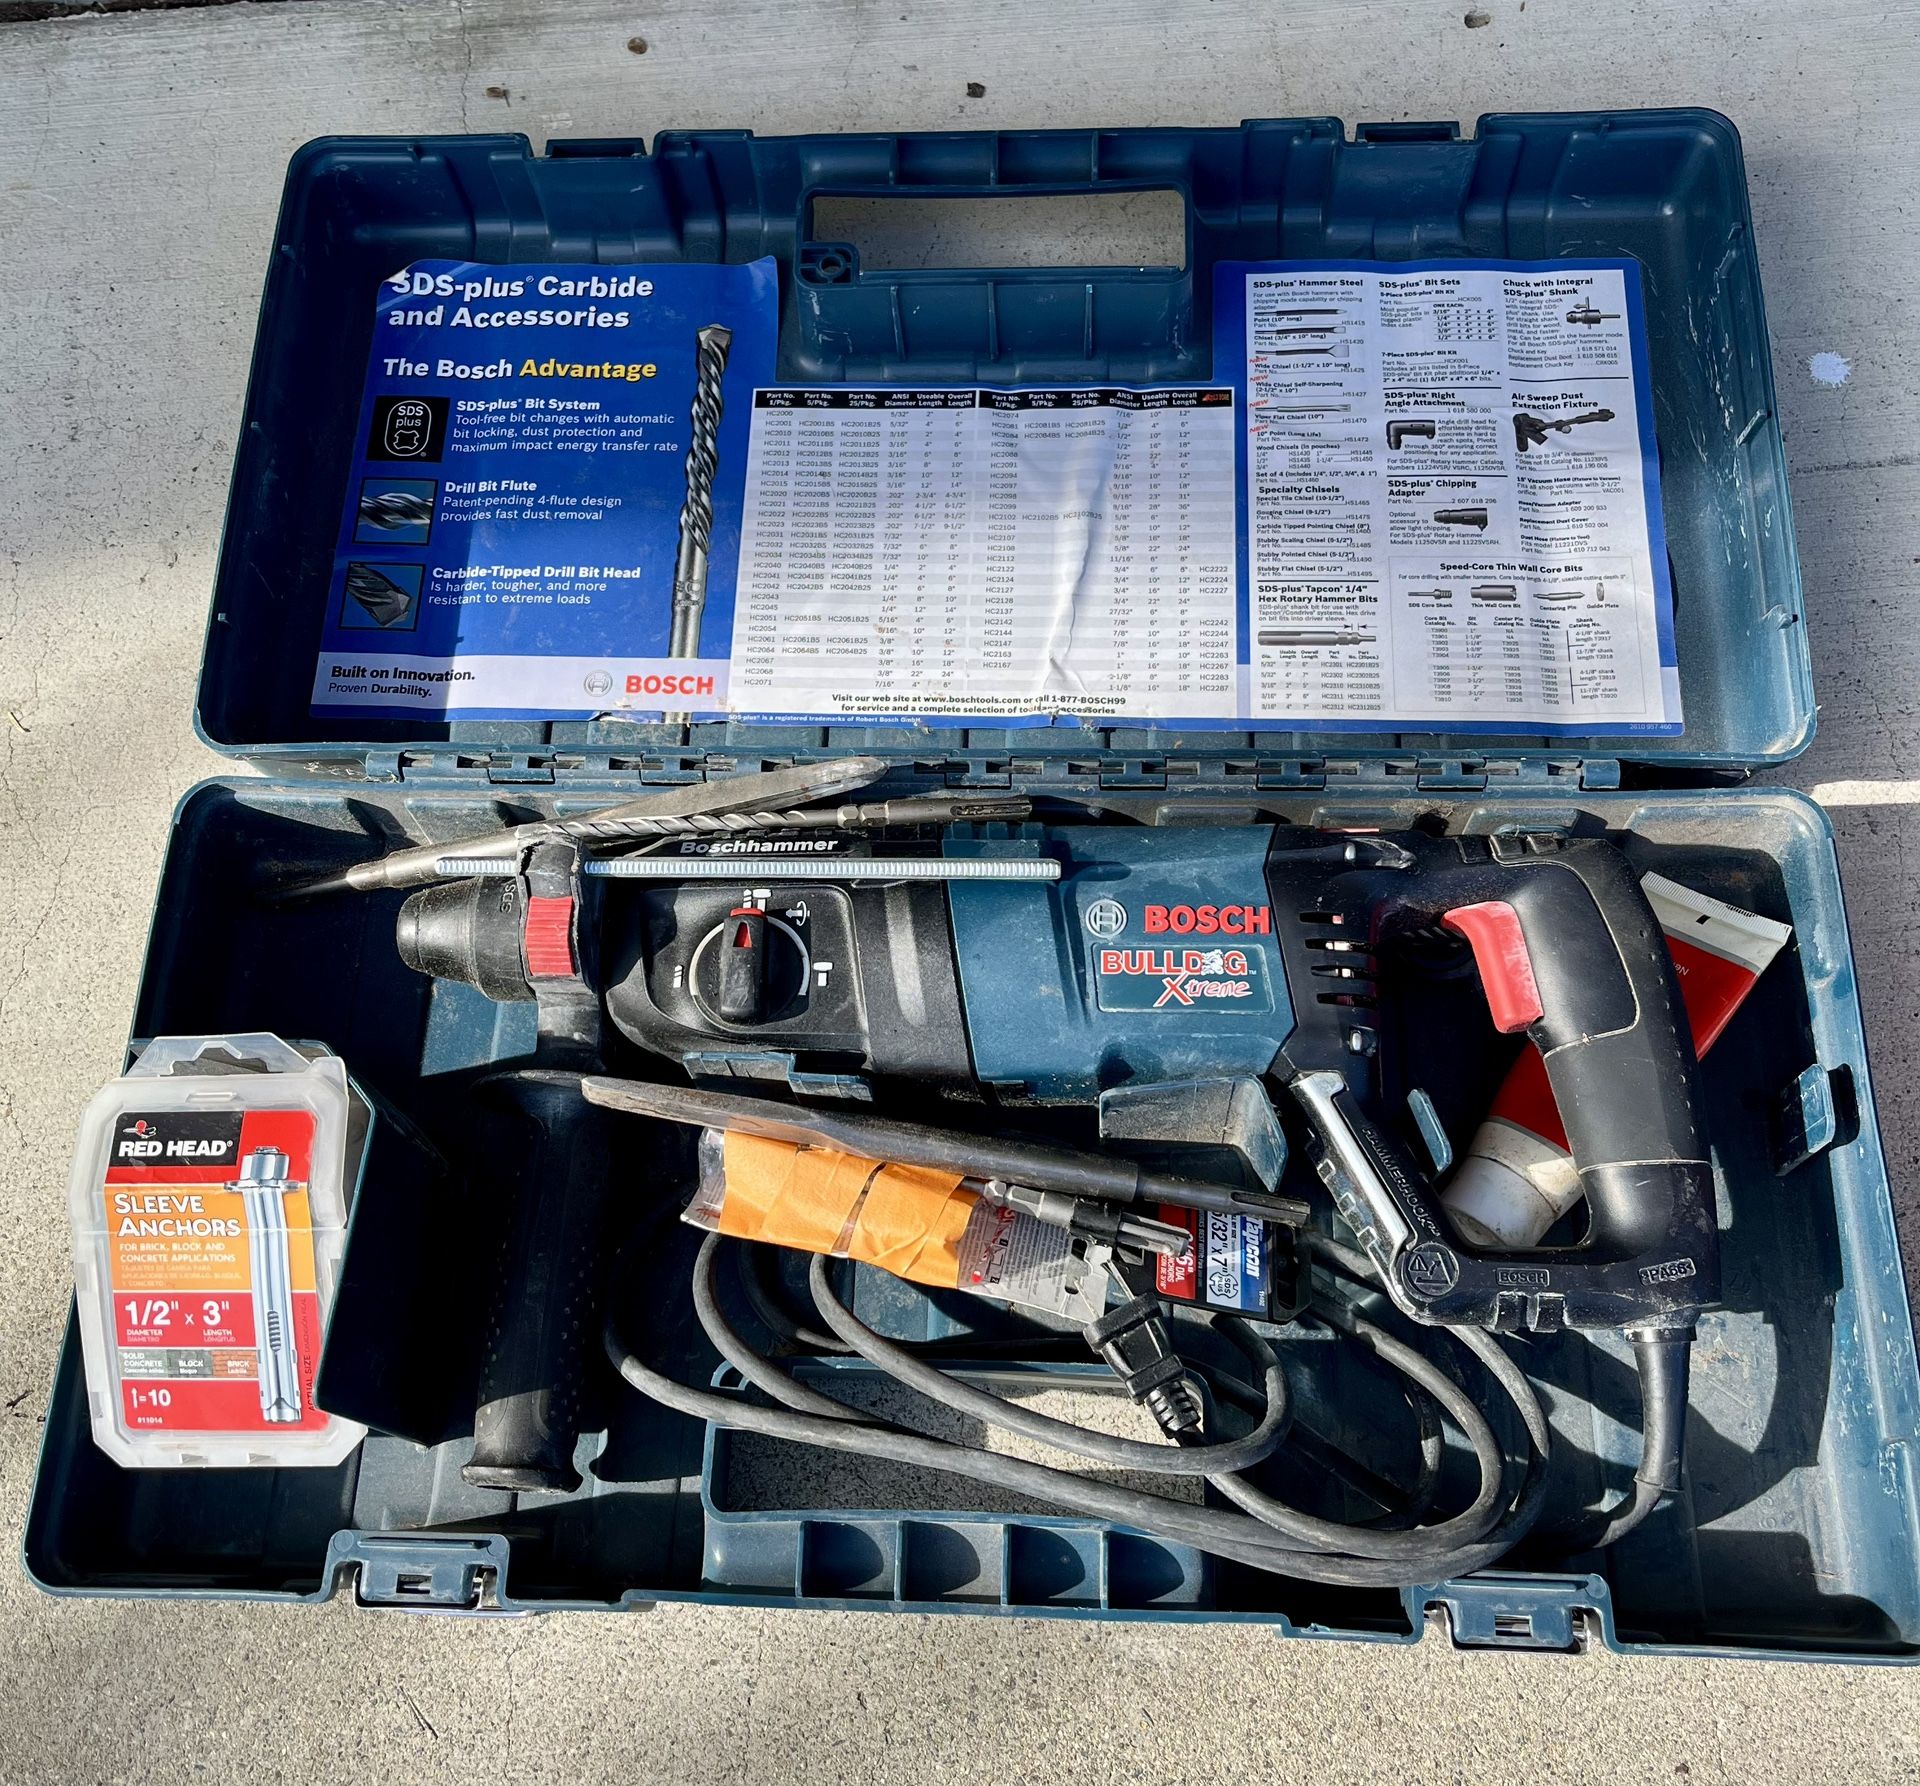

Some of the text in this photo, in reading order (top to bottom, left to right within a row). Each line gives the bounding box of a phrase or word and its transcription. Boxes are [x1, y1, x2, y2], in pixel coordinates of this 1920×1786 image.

[537, 276, 654, 298] Carbide
[1299, 279, 1338, 287] Hammer
[1339, 278, 1364, 287] Steel
[1424, 278, 1438, 286] Bit
[1440, 278, 1461, 286] Sets
[1502, 277, 1593, 288] Chuck with Integral
[1549, 287, 1579, 296] Shank
[388, 305, 630, 328] and Accessories
[383, 357, 657, 382] The Bosch Advantage
[1431, 391, 1455, 400] Right
[1511, 392, 1584, 402] Air Sweep Dust
[525, 398, 546, 410] Bit
[548, 399, 601, 412] System
[1385, 399, 1466, 408] Angle Attachment
[1512, 401, 1599, 410] Extraction Fixture
[397, 405, 424, 416] SDS
[396, 416, 422, 428] plus
[456, 412, 675, 426] Tool-free bit changes with automatic
[453, 426, 643, 440] bit locking, dust protection and
[451, 440, 678, 453] maximum impact energy transfer rate
[445, 480, 537, 493] Drill Bit Flute
[1258, 486, 1340, 494] Specialty Chisels
[1435, 480, 1477, 489] Chipping
[1388, 489, 1426, 498] Adapter
[443, 495, 622, 509] Patent-pending 4-flute design
[441, 509, 603, 522] provides fast dust removal
[432, 566, 641, 580] Carbide-Tipped Drill Bit Head
[1439, 563, 1494, 572] Speed-Core
[1496, 562, 1517, 571] Thin
[1518, 563, 1538, 572] Wall
[1540, 566, 1562, 574] Core
[430, 580, 607, 593] Is harder, tougher, and more
[1345, 585, 1368, 593] 1/4"
[428, 594, 591, 605] resistant to extreme loads
[1258, 595, 1378, 604] Hex Rotary Hammer Bits
[331, 666, 476, 682] Built on Innovation.
[328, 682, 432, 698] Proven Durability.
[625, 675, 713, 696] BOSCH
[832, 694, 852, 702] Visit
[872, 694, 891, 702] web
[923, 695, 1021, 704] www.boschtools.com
[1052, 695, 1126, 705] 1-877-BOSCH99
[841, 703, 855, 712] for
[857, 704, 890, 712] service
[892, 704, 909, 712] and
[918, 705, 961, 713] complete
[963, 705, 1005, 714] selection
[1007, 705, 1017, 714] of
[680, 838, 838, 855] Boschhammer
[501, 884, 516, 914] SDS
[1144, 904, 1270, 935] BOSCH
[1153, 972, 1253, 1007] Xtreme
[118, 1140, 164, 1157] RED
[113, 1192, 206, 1215] SLEEVE
[117, 1217, 241, 1238] ANCHORS
[119, 1242, 138, 1251] FOR
[171, 1242, 202, 1251] BLOCK
[205, 1242, 225, 1251] AND
[1211, 1246, 1222, 1255] x
[120, 1253, 236, 1263] CONCRETE APPLICATIONS
[1211, 1257, 1229, 1273] 7"
[1499, 1270, 1547, 1285] BOSCH
[1223, 1278, 1232, 1294] SDS
[124, 1300, 230, 1326] 1/2" x 3"
[203, 1328, 232, 1336] LENGTH
[178, 1359, 204, 1367] BLOCK
[227, 1359, 250, 1367] BRICK
[303, 1354, 312, 1375] SIZE
[304, 1376, 315, 1412] ACTUAL
